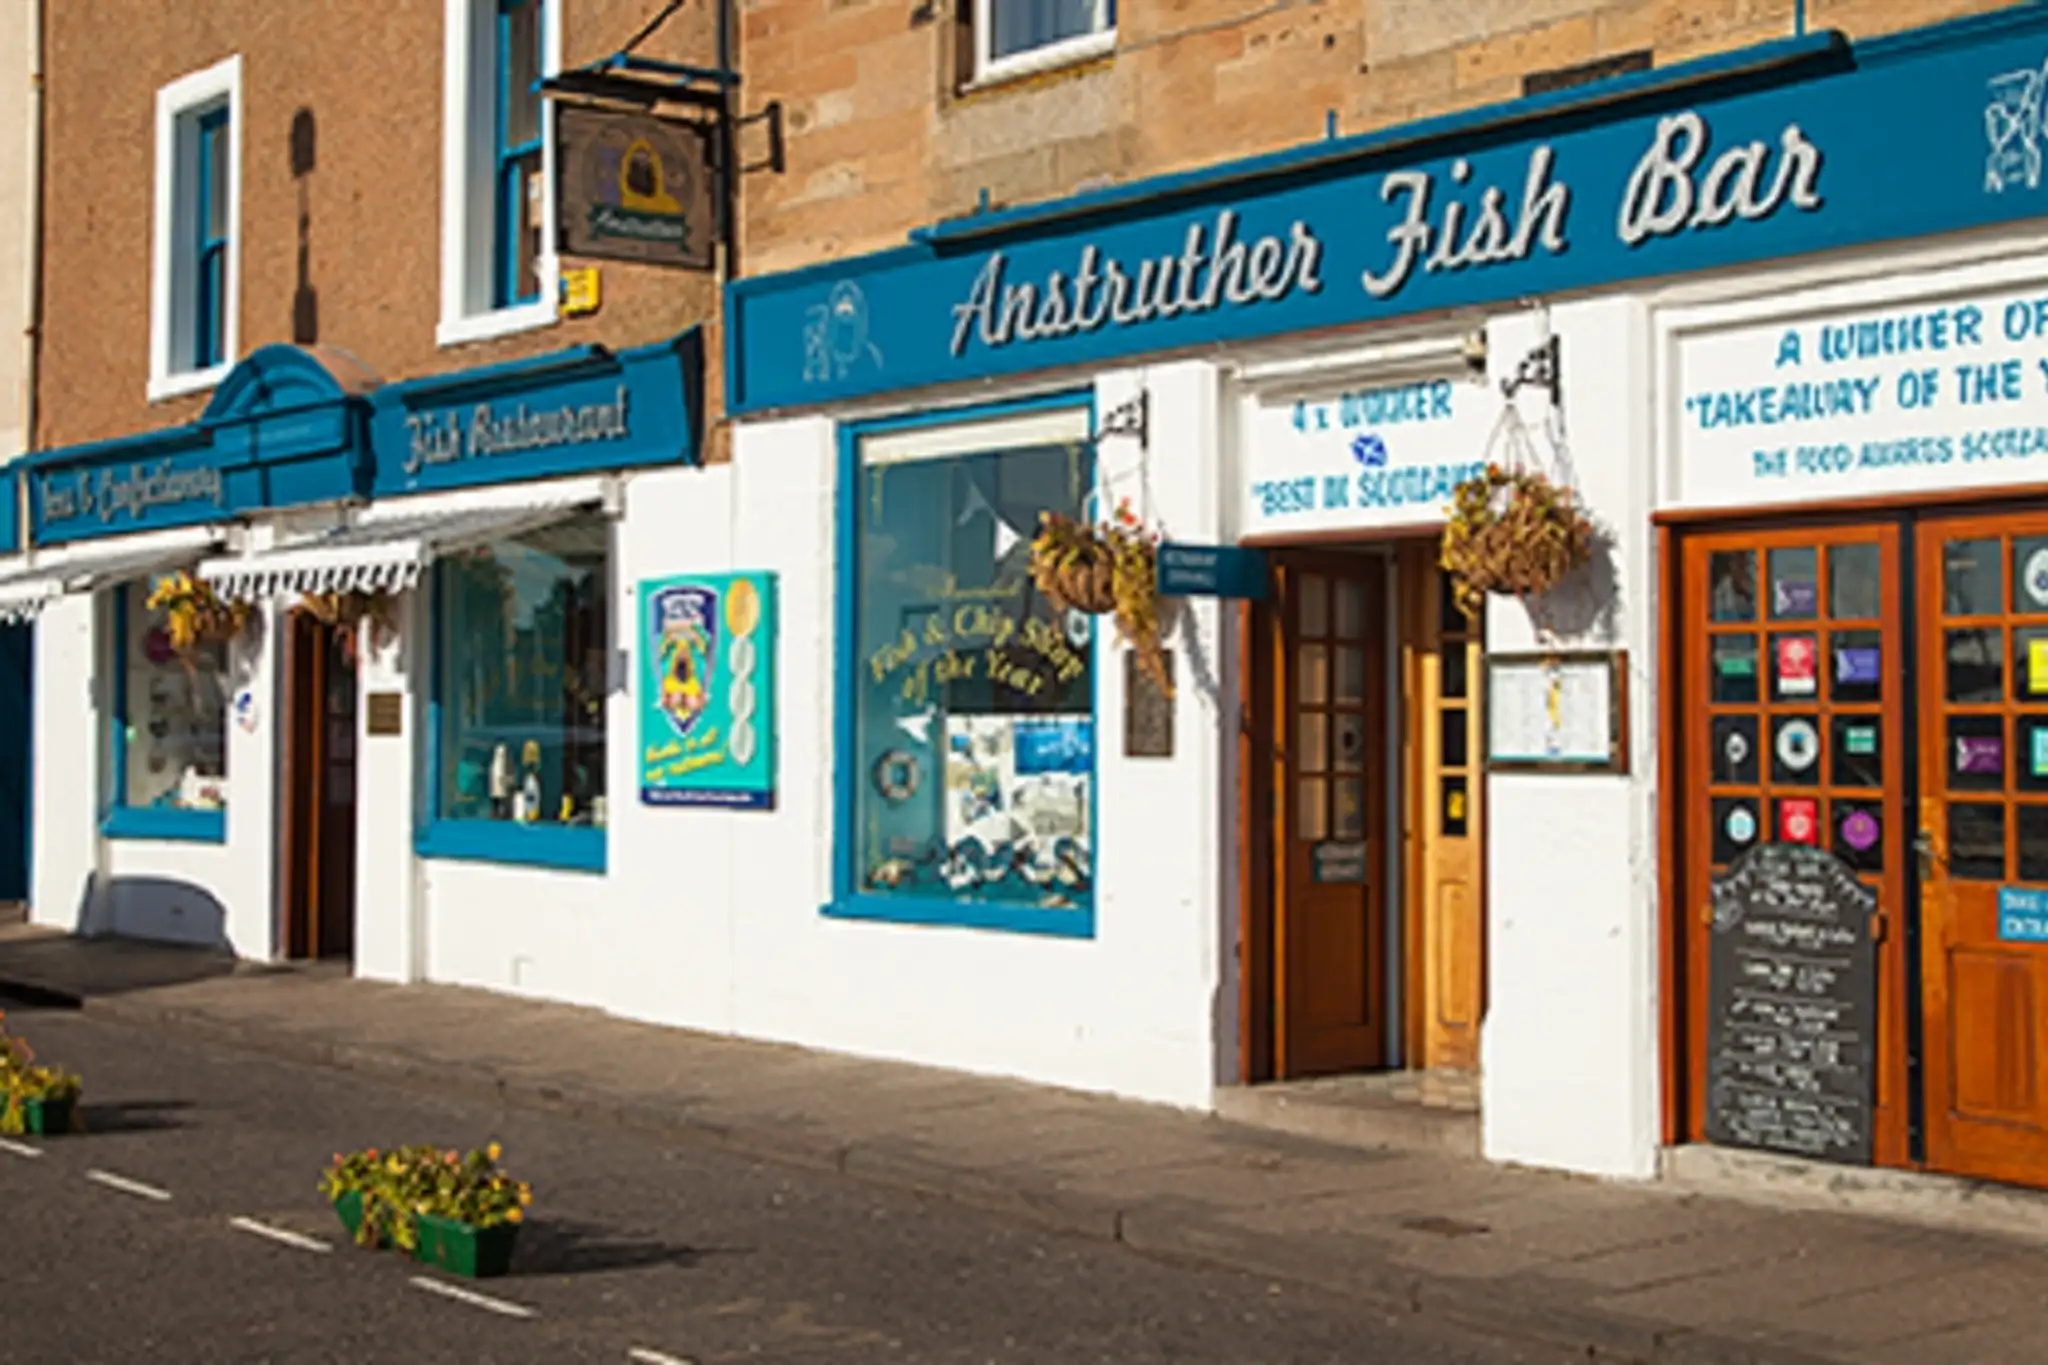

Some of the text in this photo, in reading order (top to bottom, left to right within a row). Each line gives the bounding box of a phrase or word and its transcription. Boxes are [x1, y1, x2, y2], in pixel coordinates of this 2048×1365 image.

[948, 110, 1823, 358] Anstruther Fish Bar
[1775, 299, 2048, 368] A WINNER OF
[1896, 367, 1939, 410] OF
[1955, 358, 2022, 405] THE
